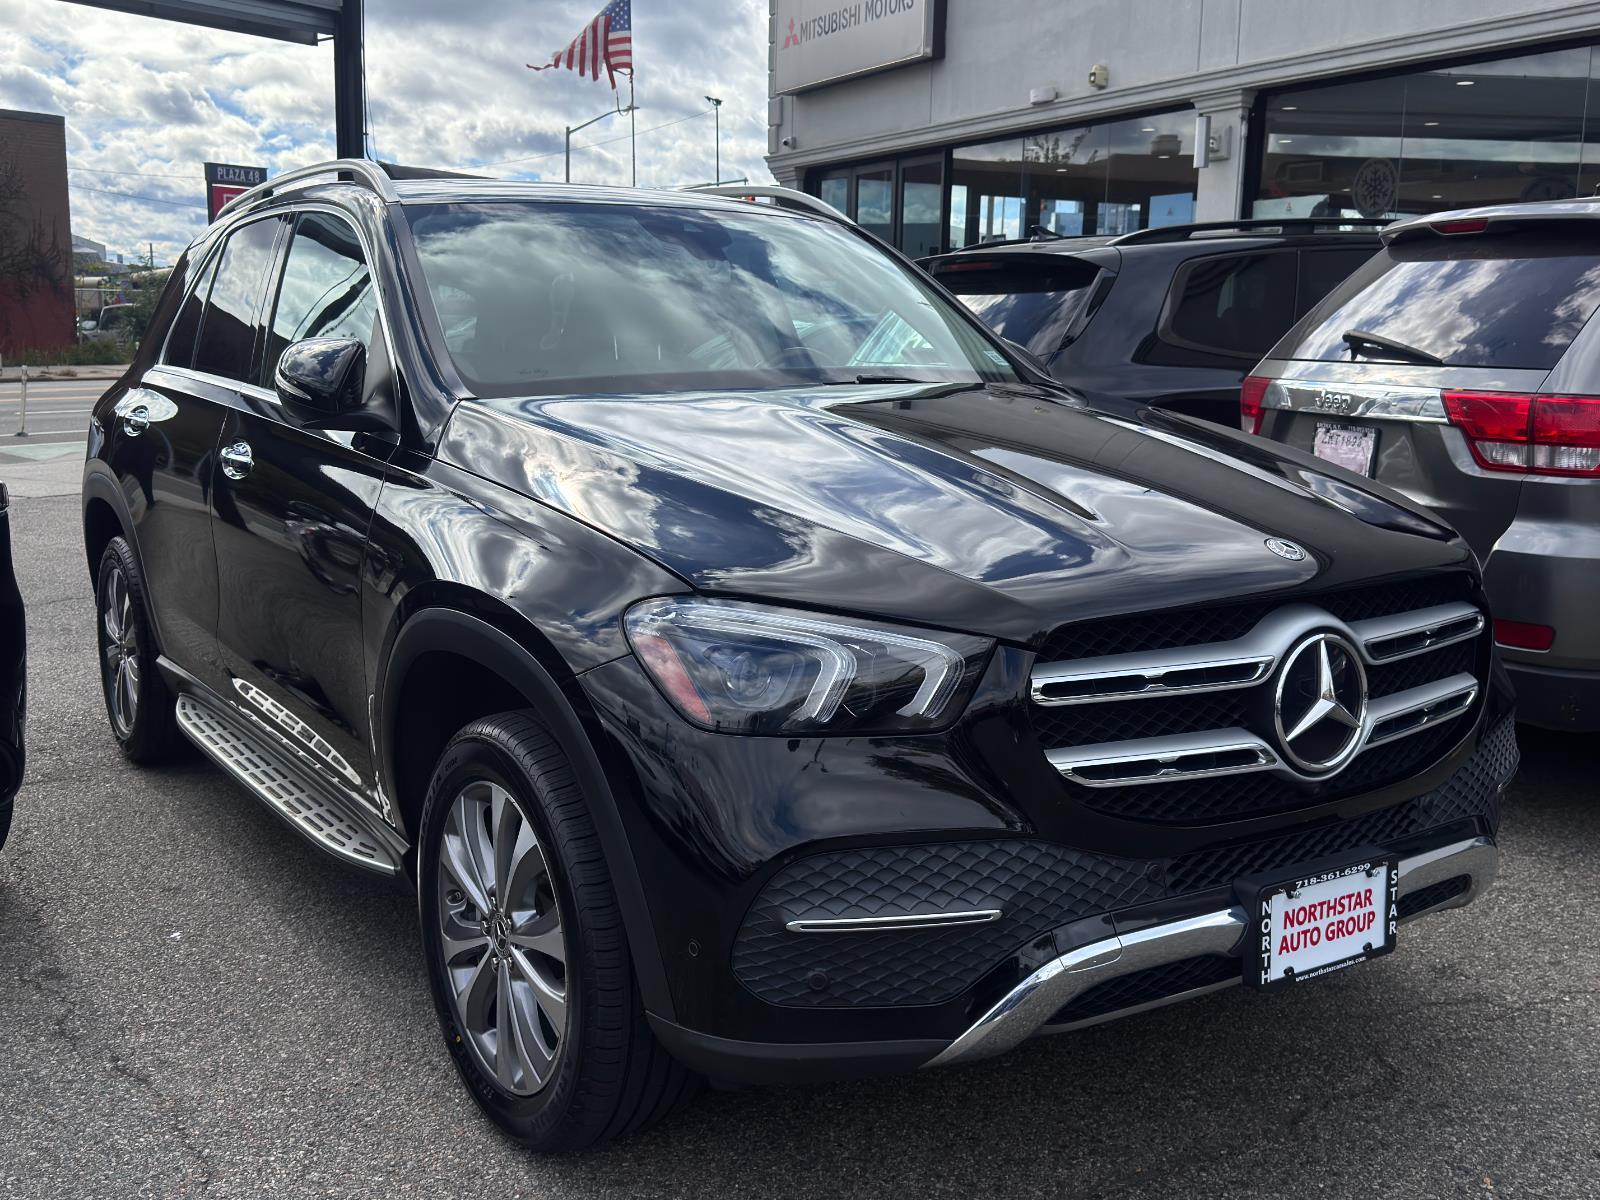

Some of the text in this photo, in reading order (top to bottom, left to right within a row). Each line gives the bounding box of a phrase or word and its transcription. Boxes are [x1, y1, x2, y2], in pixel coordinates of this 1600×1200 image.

[800, 4, 860, 43] MITSUBISHI
[217, 167, 246, 182] PLAZA
[1315, 389, 1351, 413] Jeep
[1295, 862, 1371, 889] 718-361-6299
[1283, 888, 1373, 930] NORTHSTAR
[1389, 870, 1398, 936] STAR
[1261, 900, 1271, 985] NORTH
[1278, 911, 1376, 956] AUTO GROUP
[1295, 956, 1367, 982] www.northstarcarsales.com
